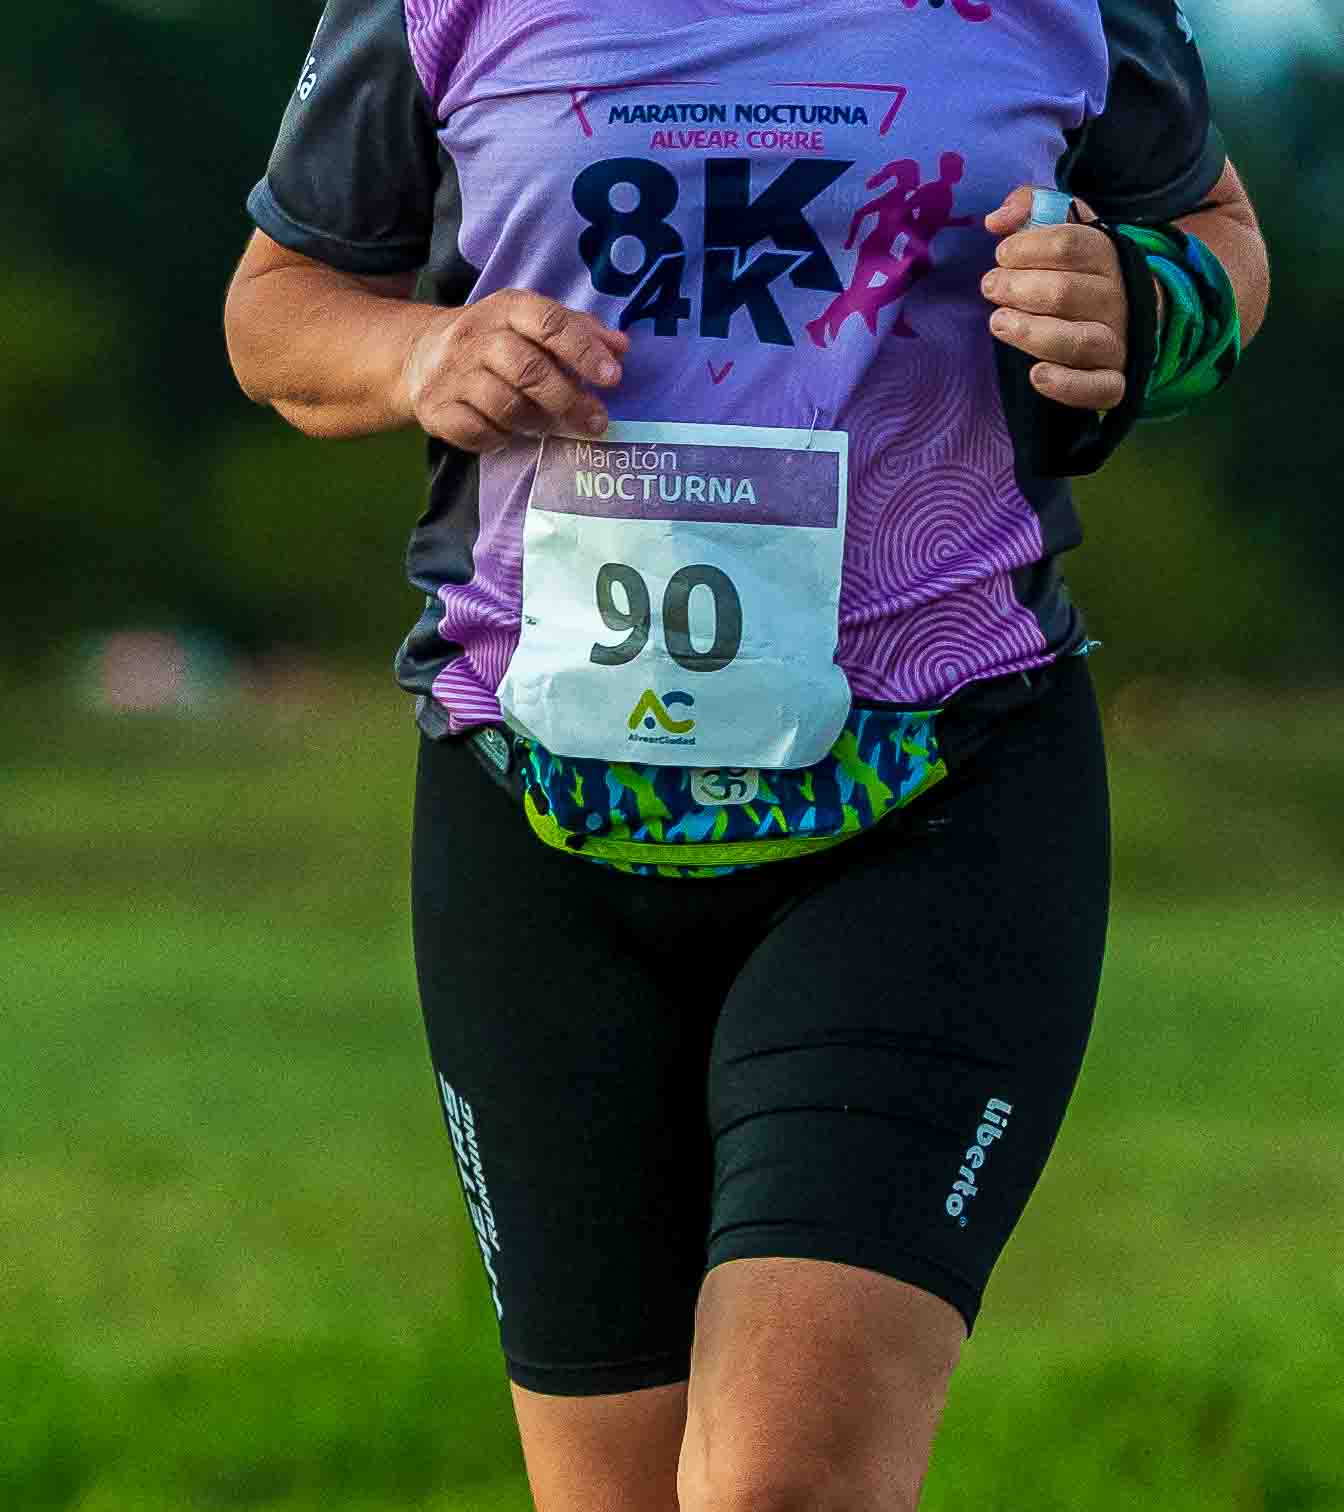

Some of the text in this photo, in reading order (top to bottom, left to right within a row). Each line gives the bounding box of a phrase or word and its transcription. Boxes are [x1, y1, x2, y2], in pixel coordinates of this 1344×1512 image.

[607, 103, 869, 125] MARATON NOCTURNA
[649, 130, 825, 151] ALVEAR CORRE
[571, 156, 857, 298] 8K
[618, 247, 813, 347] 4K
[574, 471, 758, 505] NOCTURNA
[575, 440, 677, 471] Maratón
[589, 562, 744, 673] 90
[458, 1096, 501, 1253] RUNNING
